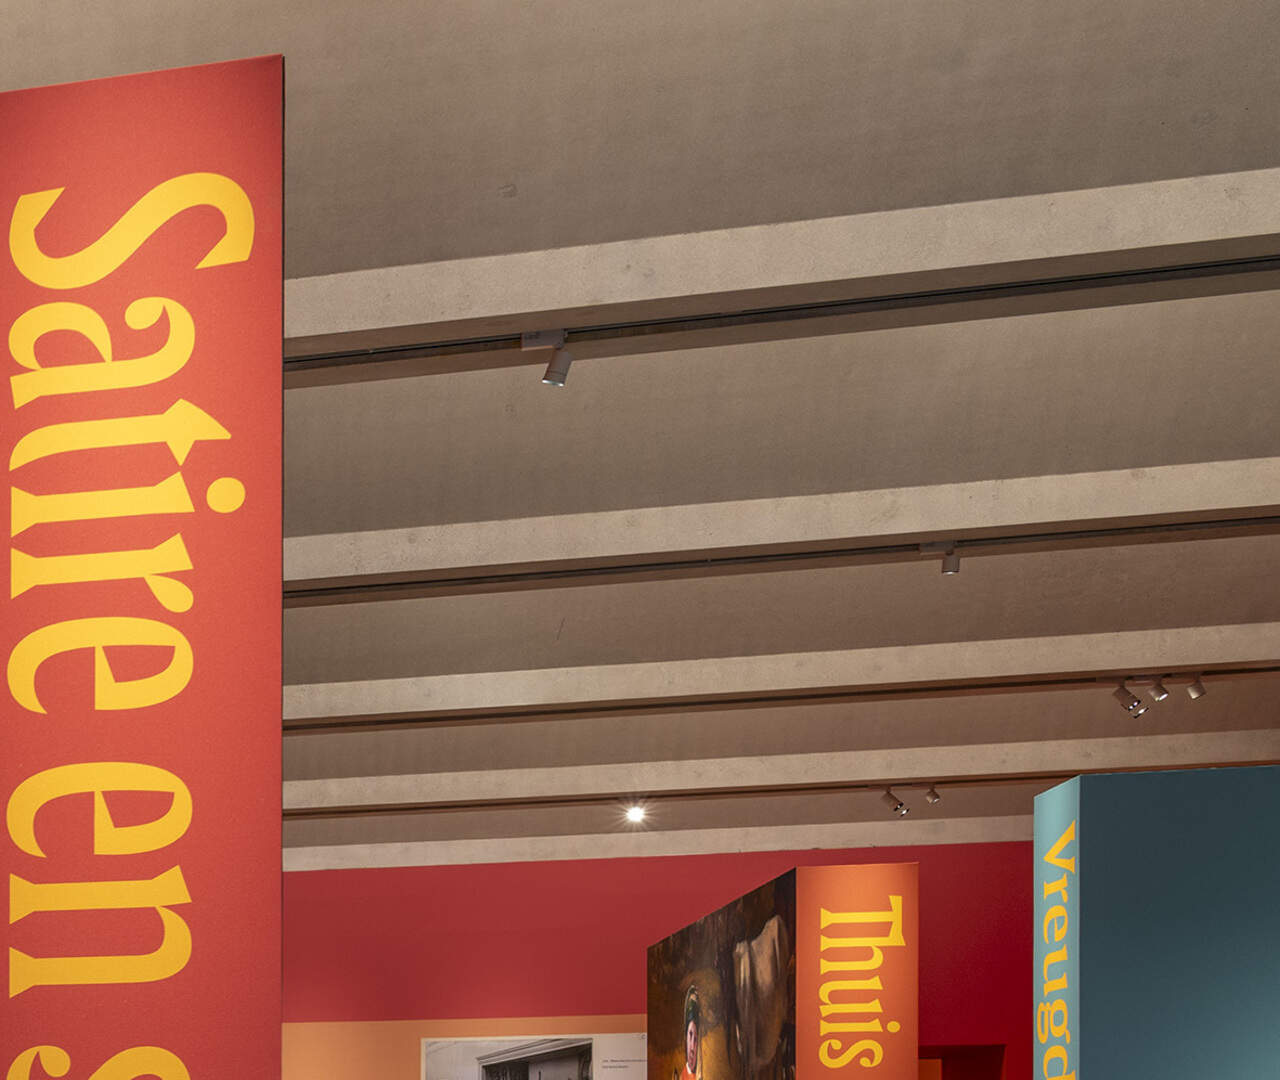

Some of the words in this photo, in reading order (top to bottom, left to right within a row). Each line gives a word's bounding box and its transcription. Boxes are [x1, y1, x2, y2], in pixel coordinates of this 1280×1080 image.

[7, 172, 255, 713] Satire
[6, 761, 192, 998] en
[819, 894, 906, 1069] Thuis
